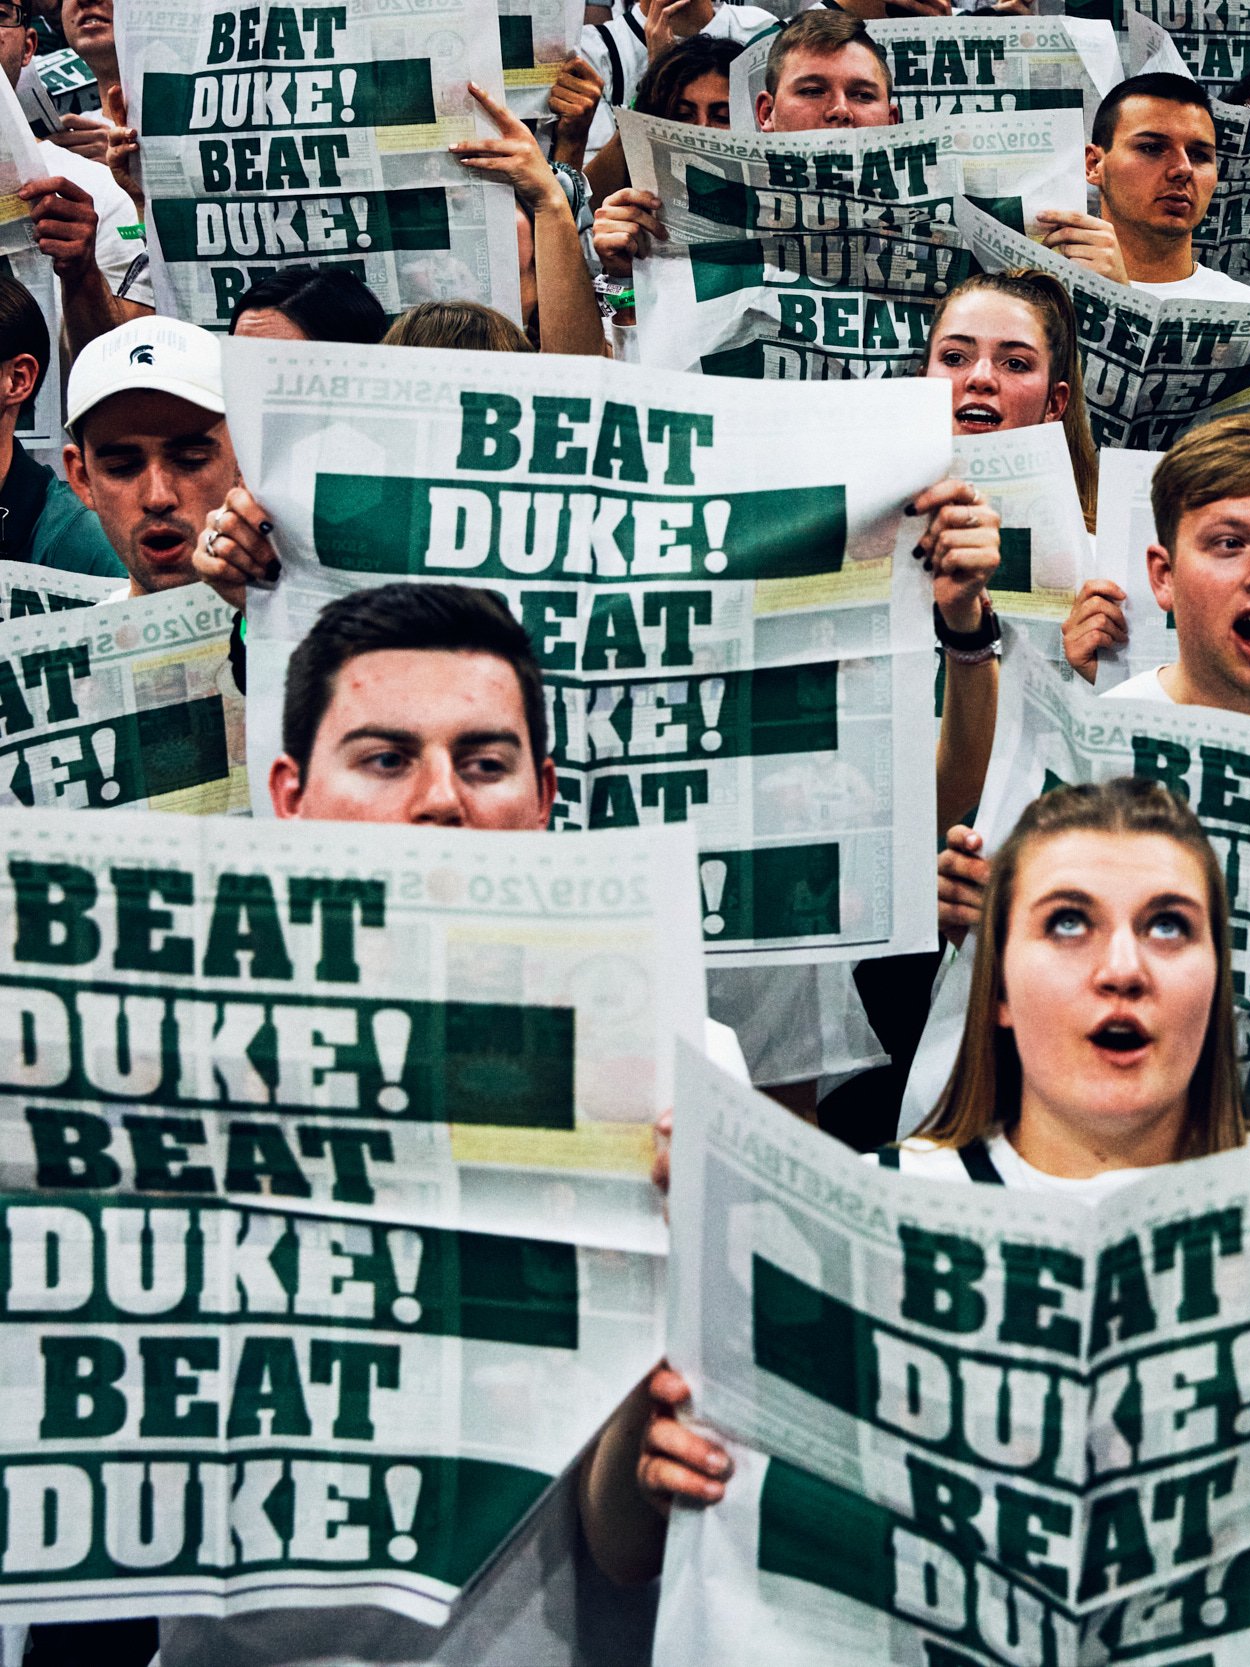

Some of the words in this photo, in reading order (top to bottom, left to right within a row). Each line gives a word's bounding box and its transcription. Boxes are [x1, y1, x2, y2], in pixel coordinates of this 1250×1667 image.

[207, 7, 346, 65] BEAT
[891, 39, 1005, 86] EAT
[189, 68, 357, 130] DUKE!
[199, 134, 349, 192] BEAT
[769, 142, 937, 200] BEAT
[196, 197, 372, 256] DUKE!
[762, 236, 953, 294] DUKE!
[777, 293, 935, 349] BEAT
[1072, 288, 1235, 366] BEAT
[1083, 352, 1227, 420] UKE!
[456, 391, 713, 486] BEAT
[424, 487, 732, 577] DUKE!
[500, 590, 712, 672] EAT
[547, 678, 726, 762] KE!
[9, 860, 386, 983] BEAT
[0, 988, 412, 1113] DUKE!
[25, 1107, 395, 1205] BEAT
[5, 1205, 424, 1324] DUKE!
[898, 1206, 1243, 1357] BEAT
[39, 1336, 401, 1440] BEAT
[2, 1459, 423, 1574] DUKE!
[905, 1453, 1240, 1606] BEAT
